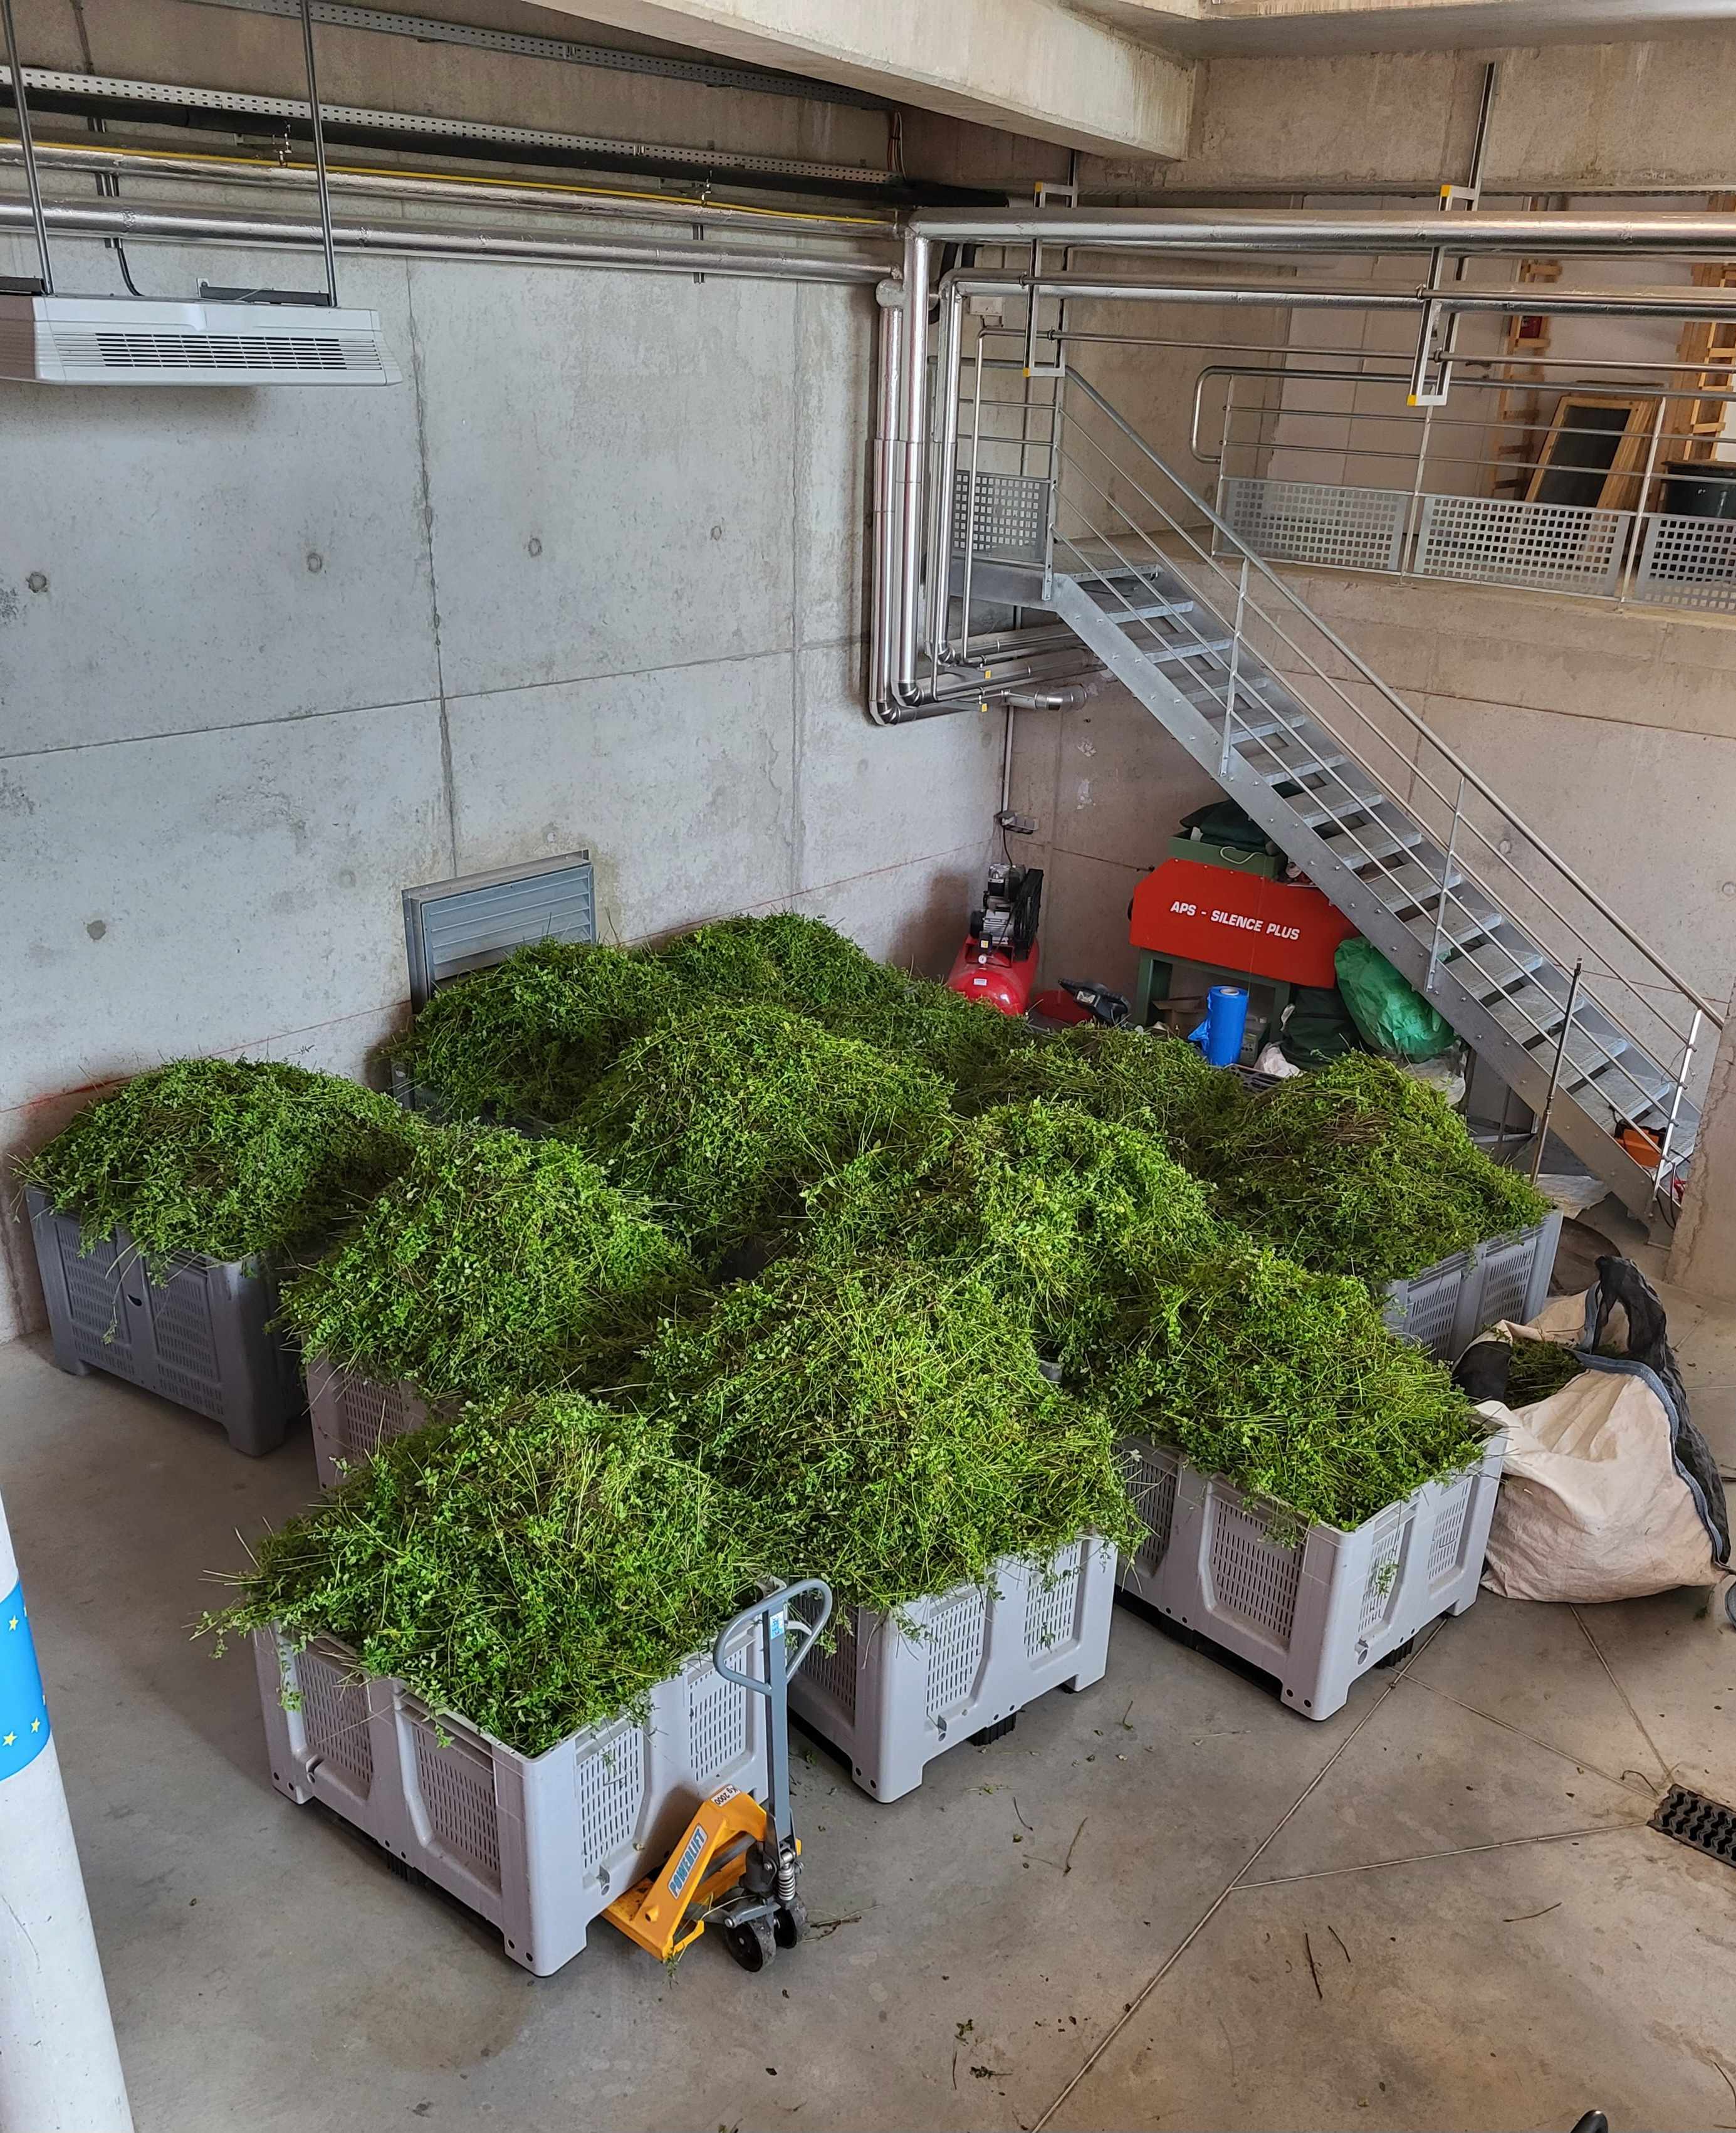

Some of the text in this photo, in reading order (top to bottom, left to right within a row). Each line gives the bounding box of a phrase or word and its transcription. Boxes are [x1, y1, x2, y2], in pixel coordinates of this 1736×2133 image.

[1170, 901, 1197, 916] APS
[1210, 909, 1264, 932] SILENCE
[1266, 923, 1300, 941] PLUS
[714, 1792, 730, 1805] 2000
[669, 1828, 705, 1897] POWERLIFT
